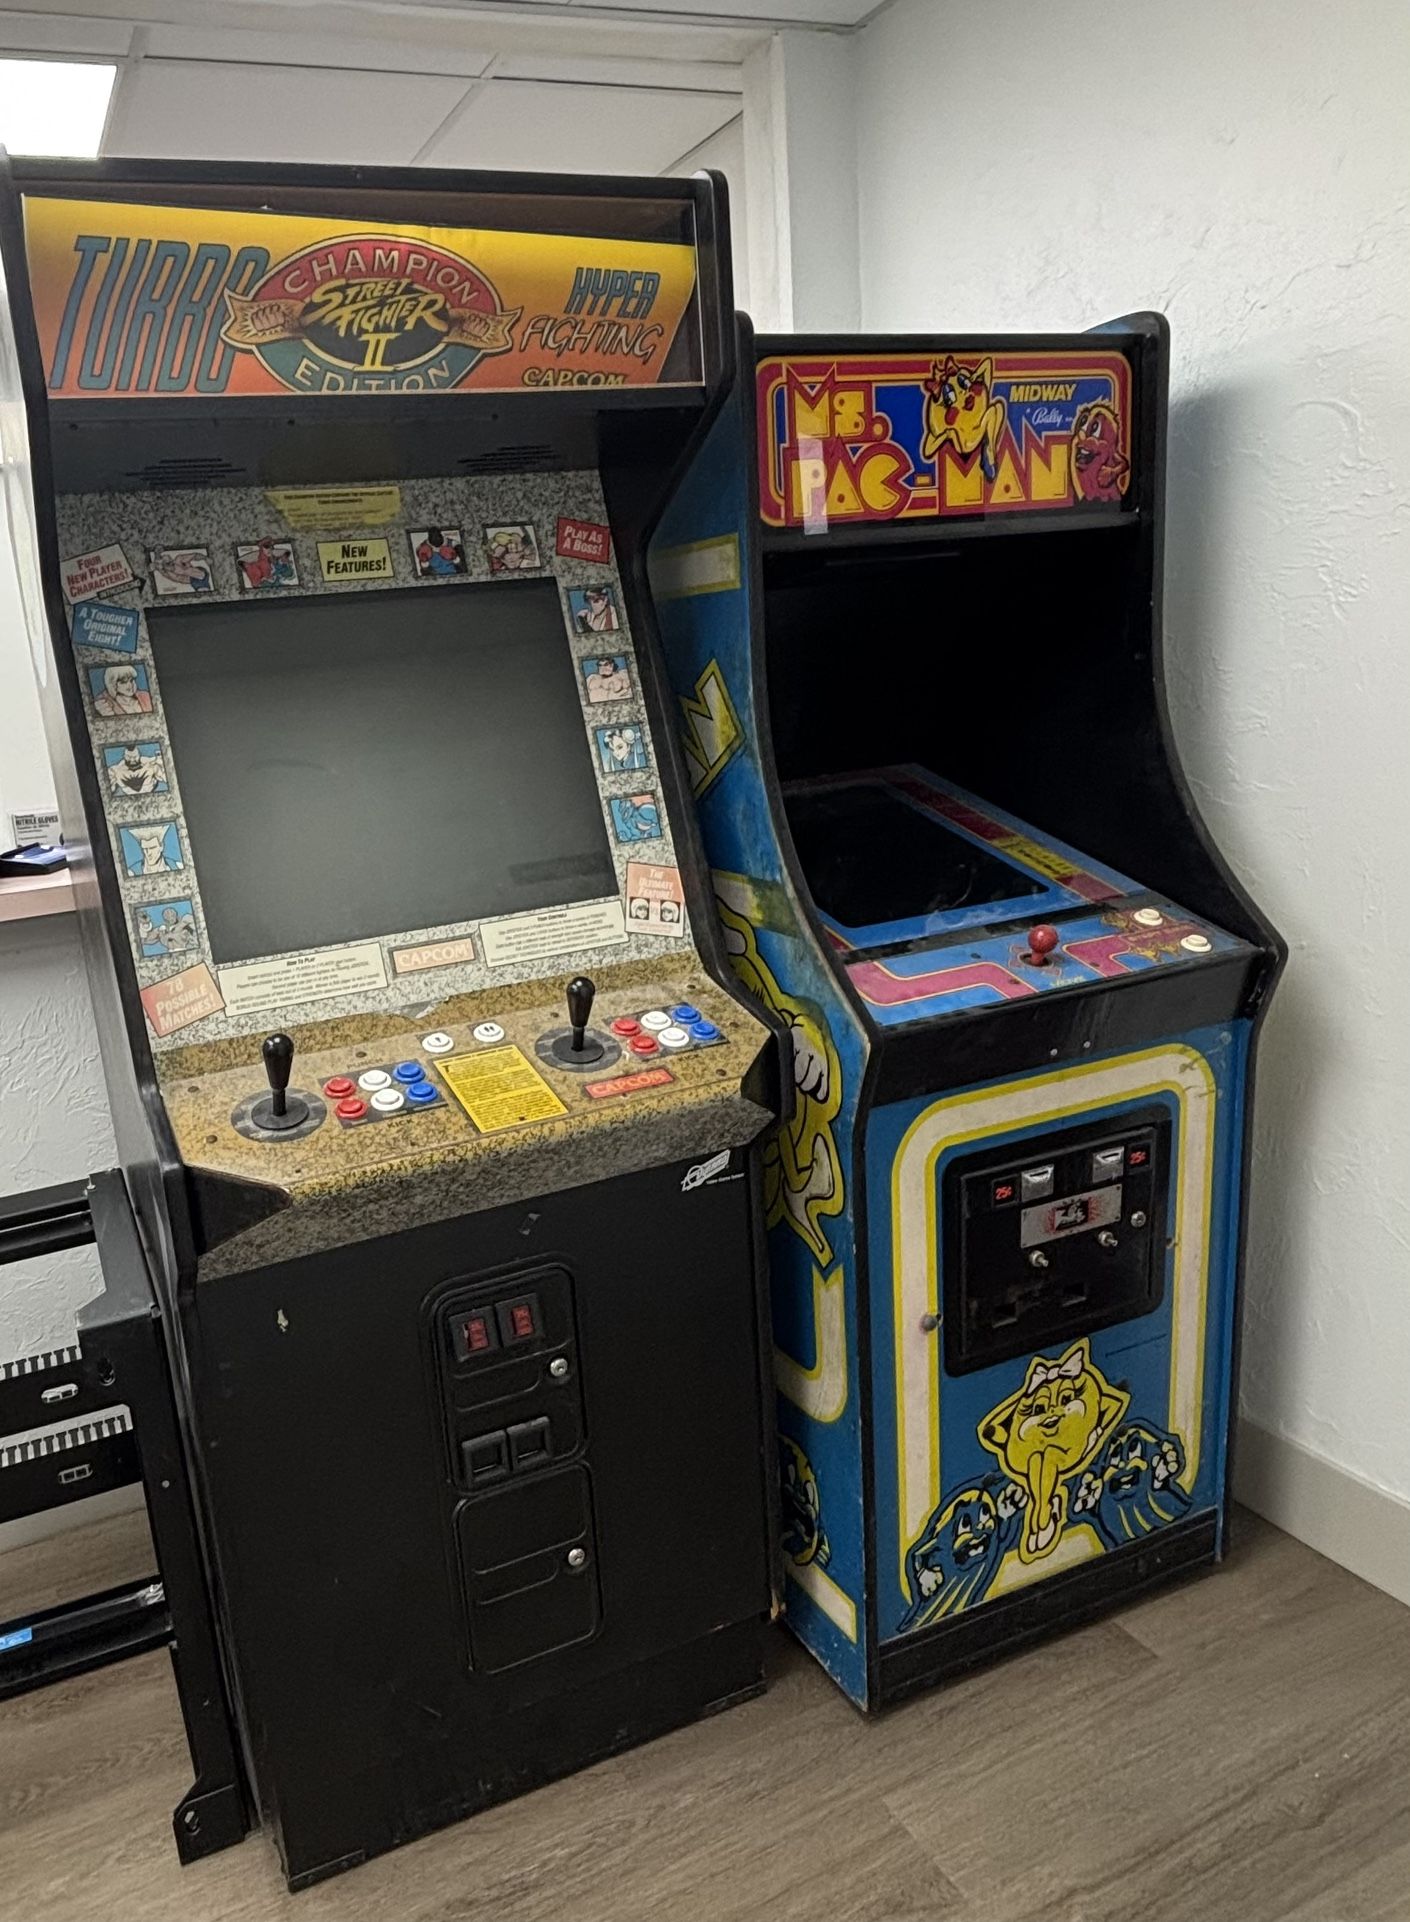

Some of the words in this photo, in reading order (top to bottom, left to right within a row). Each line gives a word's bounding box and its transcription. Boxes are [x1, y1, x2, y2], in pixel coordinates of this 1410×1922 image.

[283, 248, 479, 305] CHAMPION
[305, 278, 412, 326] STREET
[563, 267, 661, 320] HYPER
[48, 234, 271, 393] TURBO
[318, 290, 450, 338] FIGHTER
[352, 332, 402, 372] II
[519, 316, 663, 366] FIGHTING
[294, 358, 451, 392] EDITION
[521, 367, 629, 387] CAPCOM
[1009, 383, 1077, 403] MIDWAY
[1031, 406, 1063, 427] Bally
[786, 434, 1071, 520] PAC-MAN
[564, 525, 588, 540] PLAY
[588, 530, 603, 543] AS
[341, 544, 368, 559] NEW
[563, 538, 571, 549] A
[572, 540, 603, 556] BOSS!
[88, 560, 123, 579] PLAYER
[326, 556, 386, 575] FEATURES!
[396, 947, 467, 969] CAPCOM
[166, 977, 184, 995] 78
[156, 983, 208, 1018] POSSIBLE
[158, 992, 215, 1032] MATCHES!
[592, 1073, 664, 1093] CAPCOM
[386, 1118, 414, 1129] KICK
